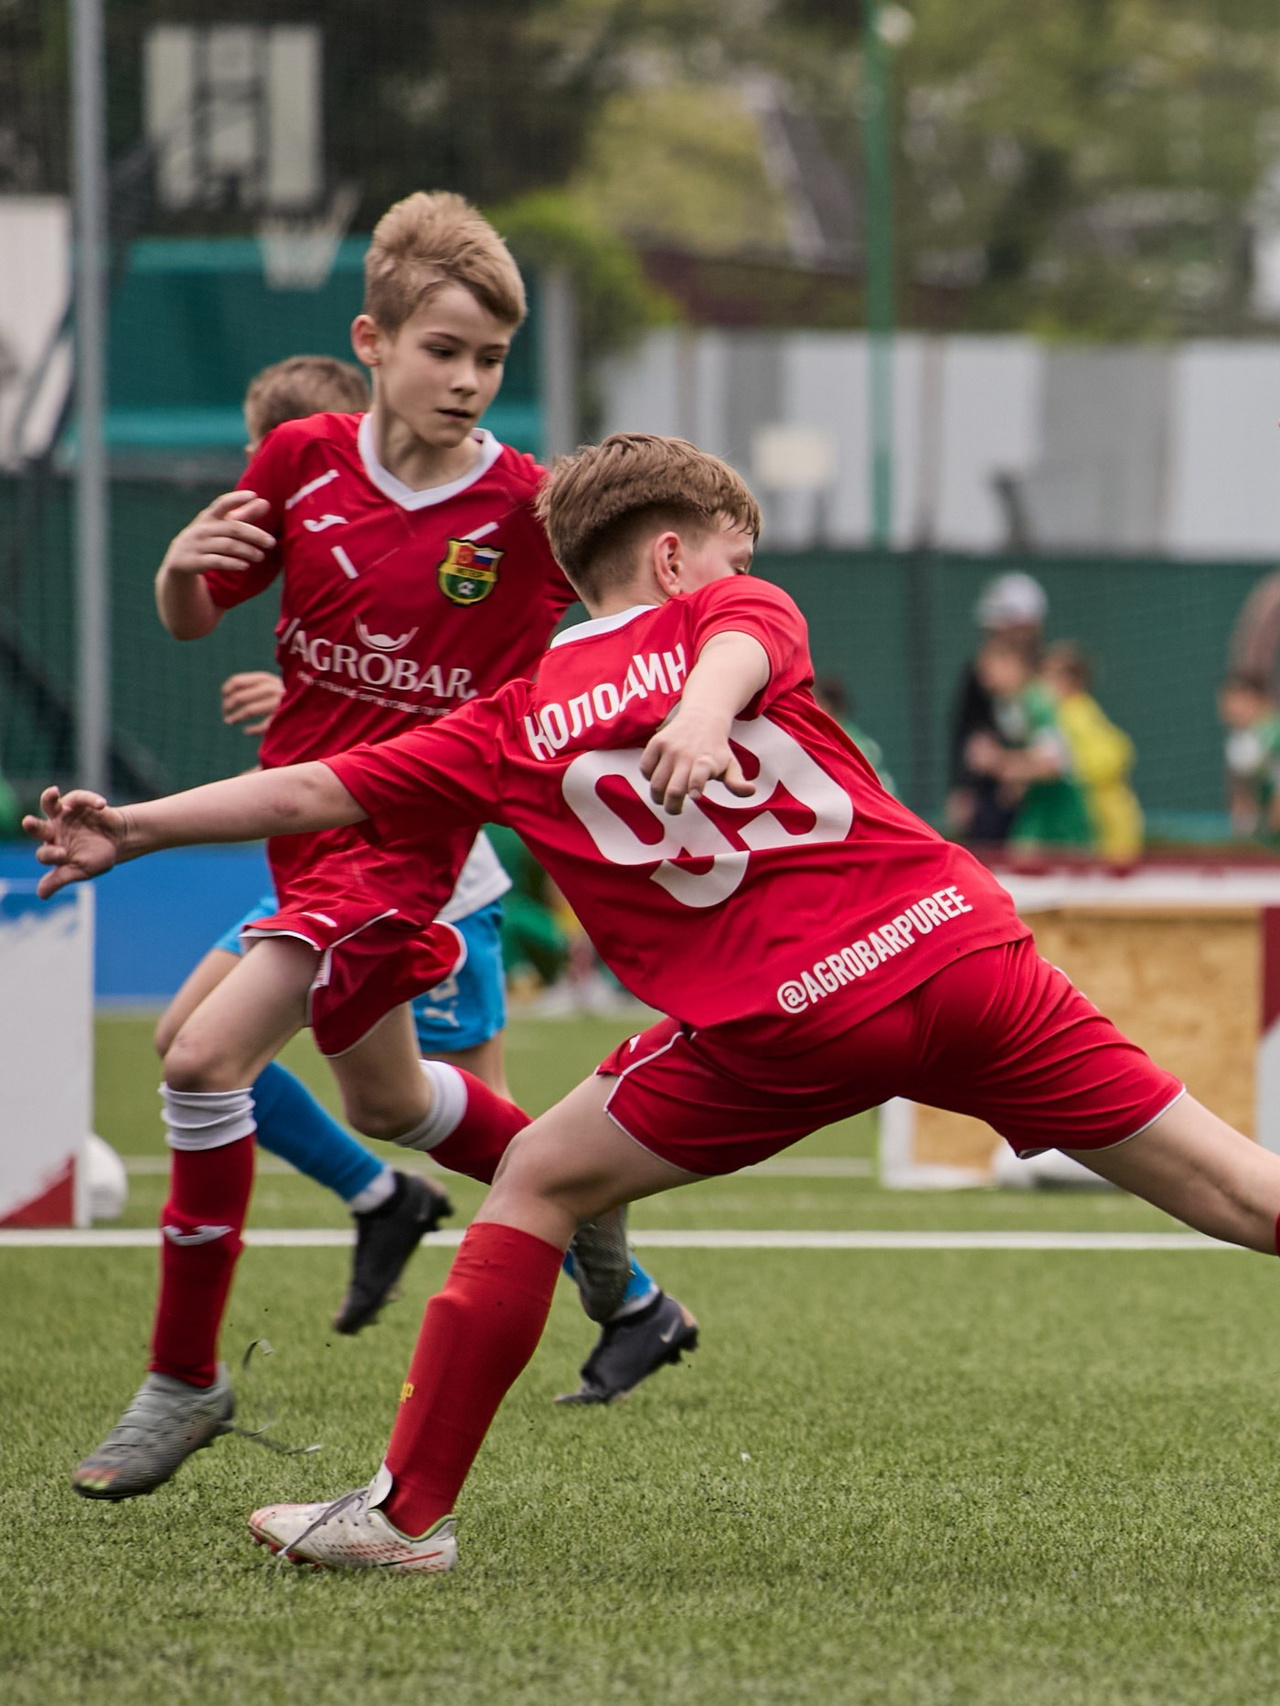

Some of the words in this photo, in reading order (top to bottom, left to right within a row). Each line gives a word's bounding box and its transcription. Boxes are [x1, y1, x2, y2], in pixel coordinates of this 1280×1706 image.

[290, 630, 479, 702] AGROBAR
[524, 643, 687, 761] КОЛОДИН
[562, 714, 853, 908] 99
[777, 885, 973, 1014] @AGROBARPUREE
